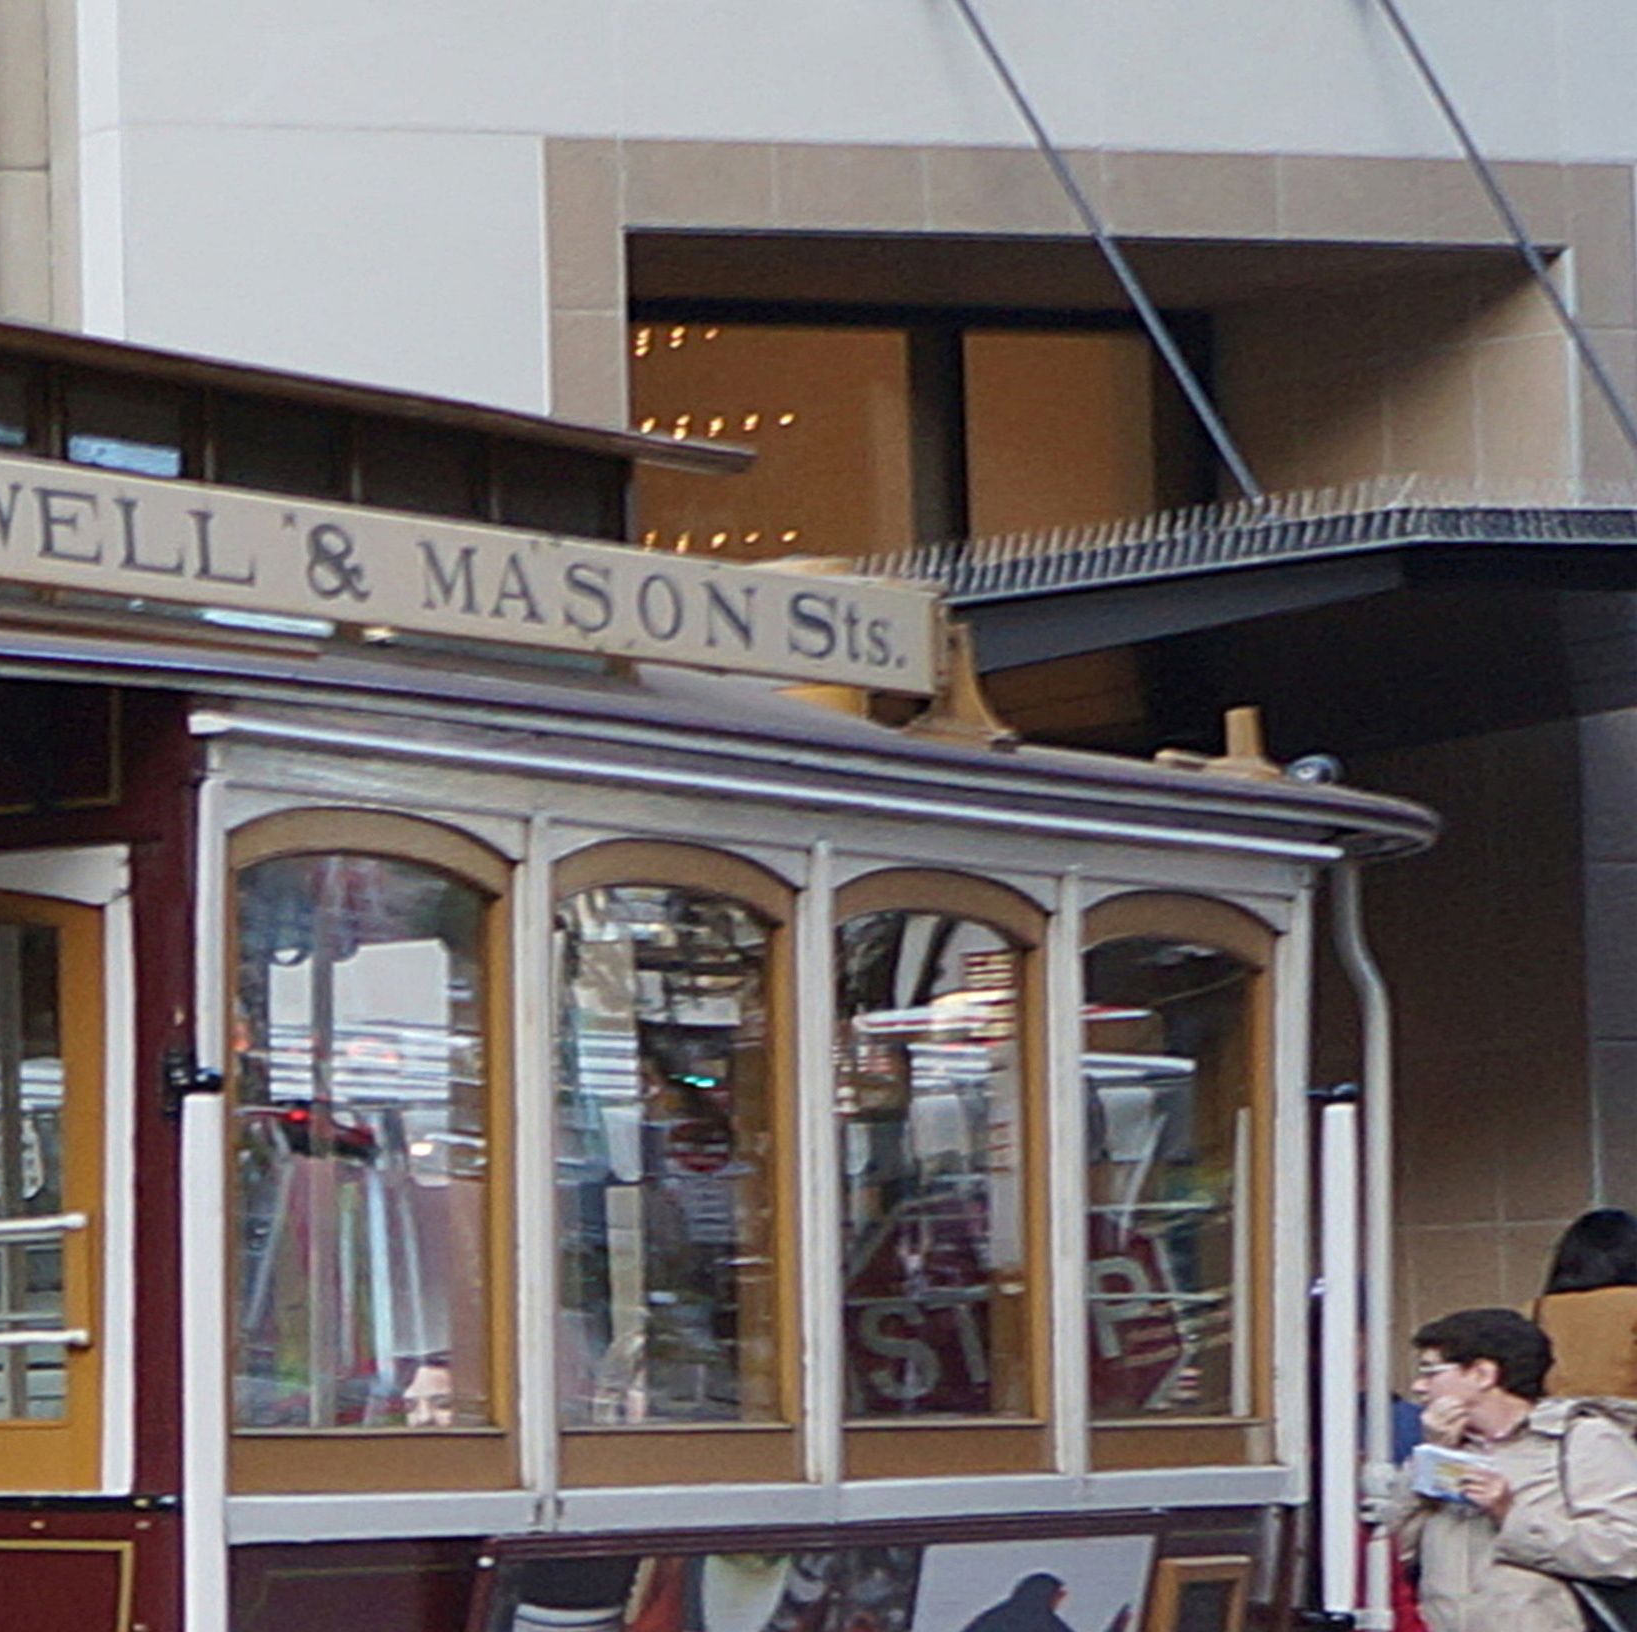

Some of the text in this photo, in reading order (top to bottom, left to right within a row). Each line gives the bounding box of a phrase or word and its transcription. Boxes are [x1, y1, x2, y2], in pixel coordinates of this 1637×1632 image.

[305, 521, 372, 602] &
[417, 539, 759, 651] MASON
[787, 590, 908, 669] Sts.
